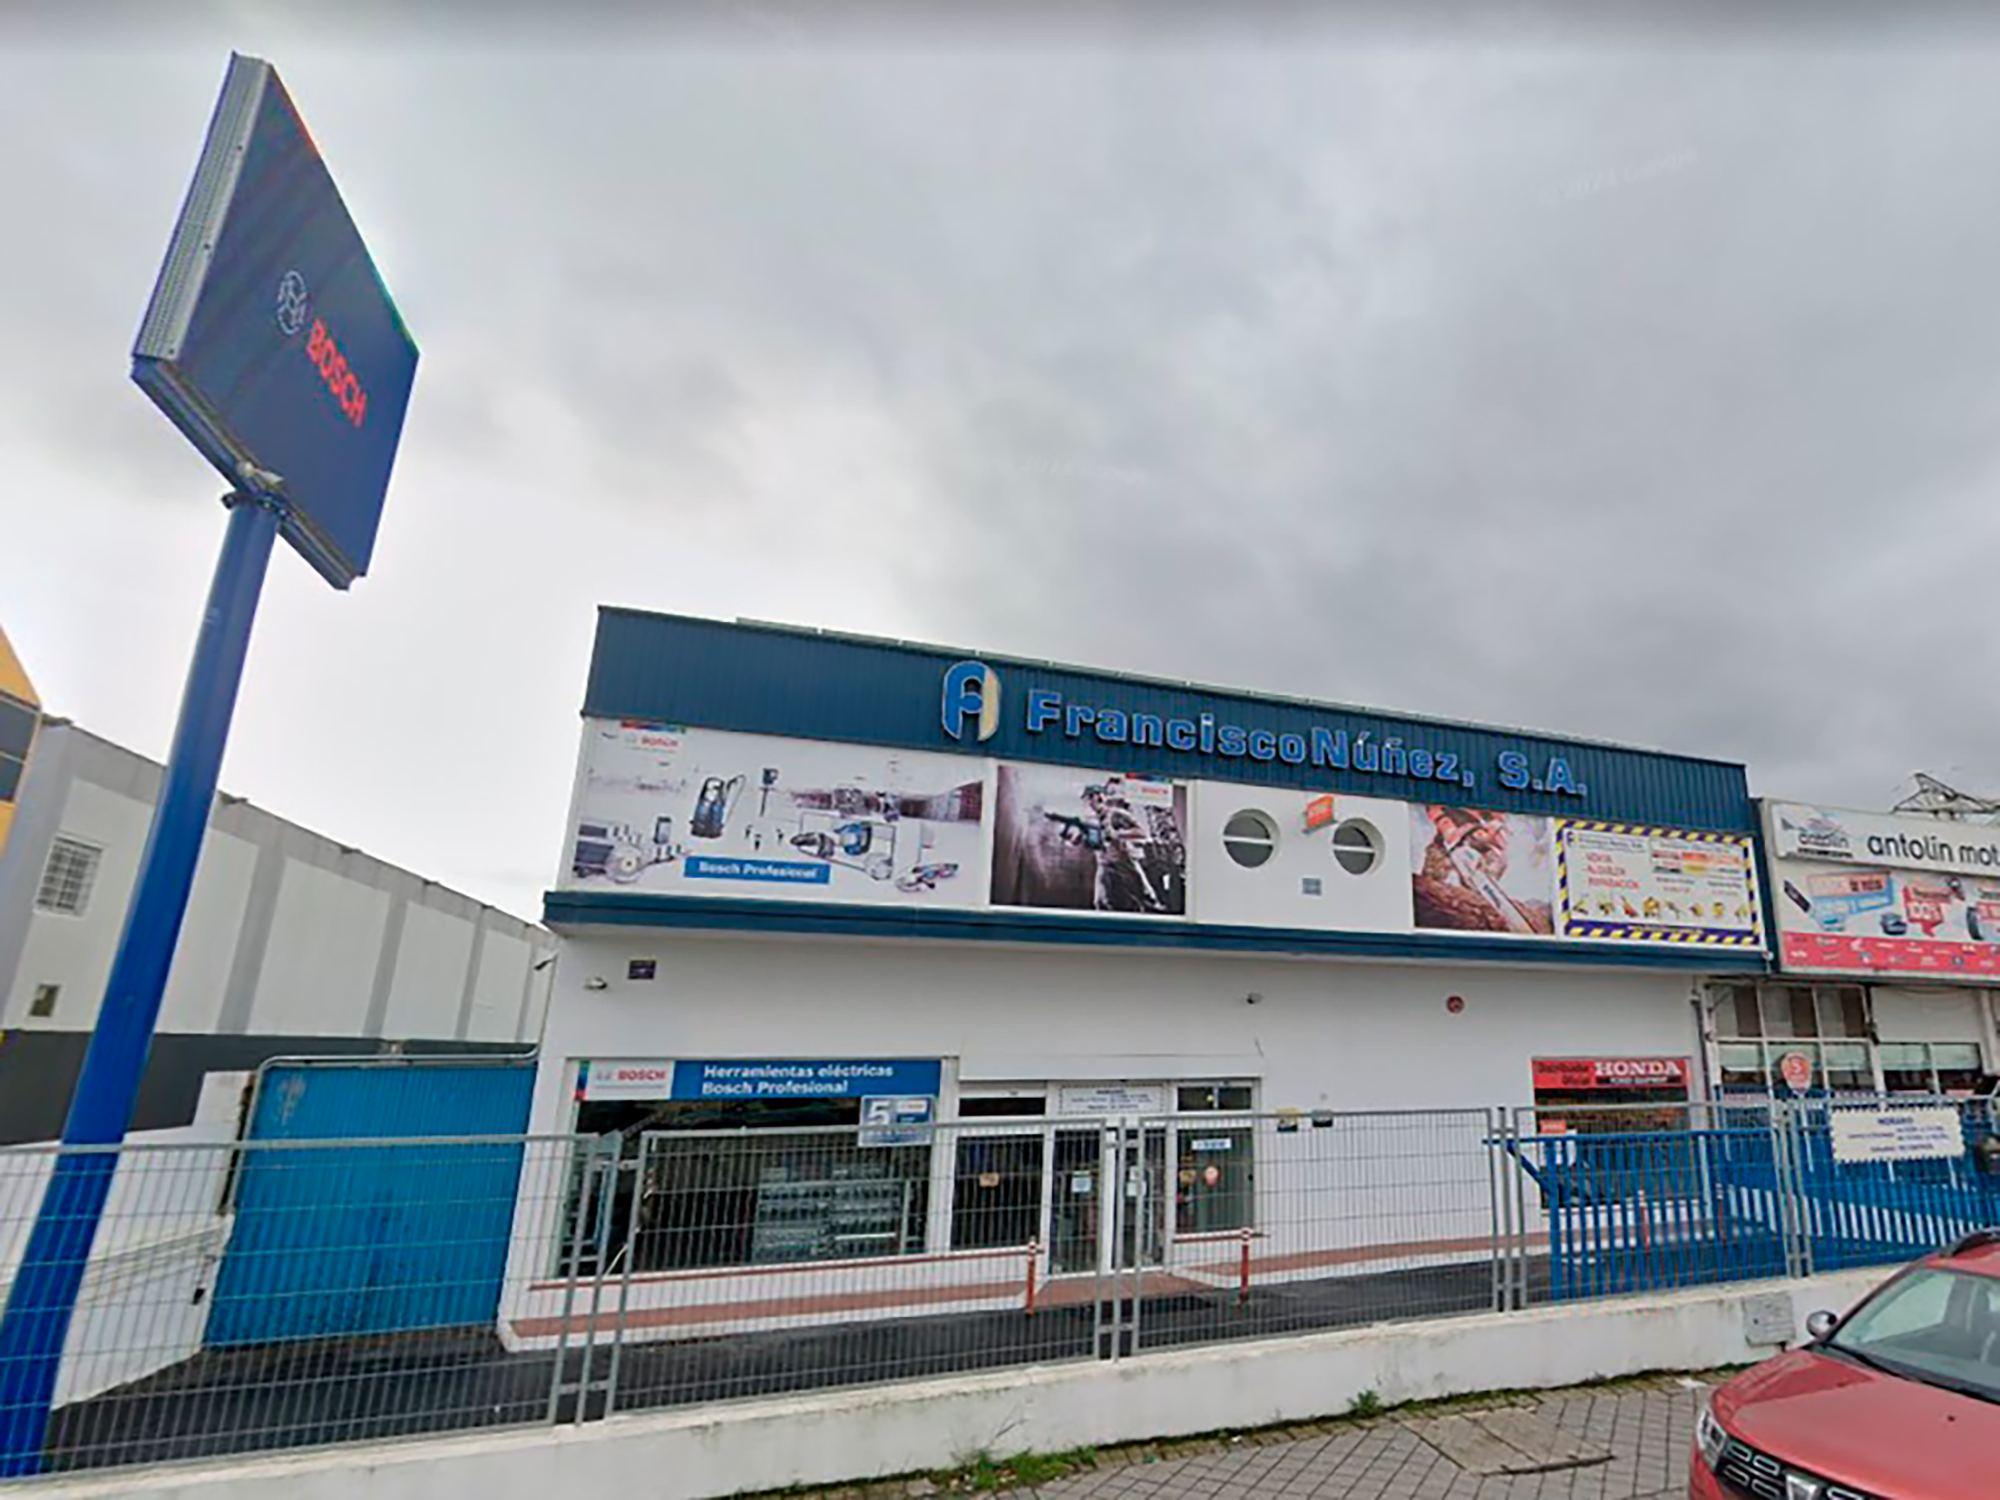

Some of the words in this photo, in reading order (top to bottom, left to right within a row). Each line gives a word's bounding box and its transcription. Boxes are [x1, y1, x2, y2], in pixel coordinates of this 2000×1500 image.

[306, 318, 367, 429] BOSCH
[1498, 751, 1588, 796] S.A.
[618, 1069, 666, 1081] BOSCH
[704, 1065, 814, 1078] Herramientas
[818, 1063, 894, 1077] eléctricas
[1595, 1061, 1682, 1076] HONDA
[702, 1080, 752, 1094] Bosch
[756, 1079, 848, 1094] Profesional
[868, 1101, 890, 1126] 5
